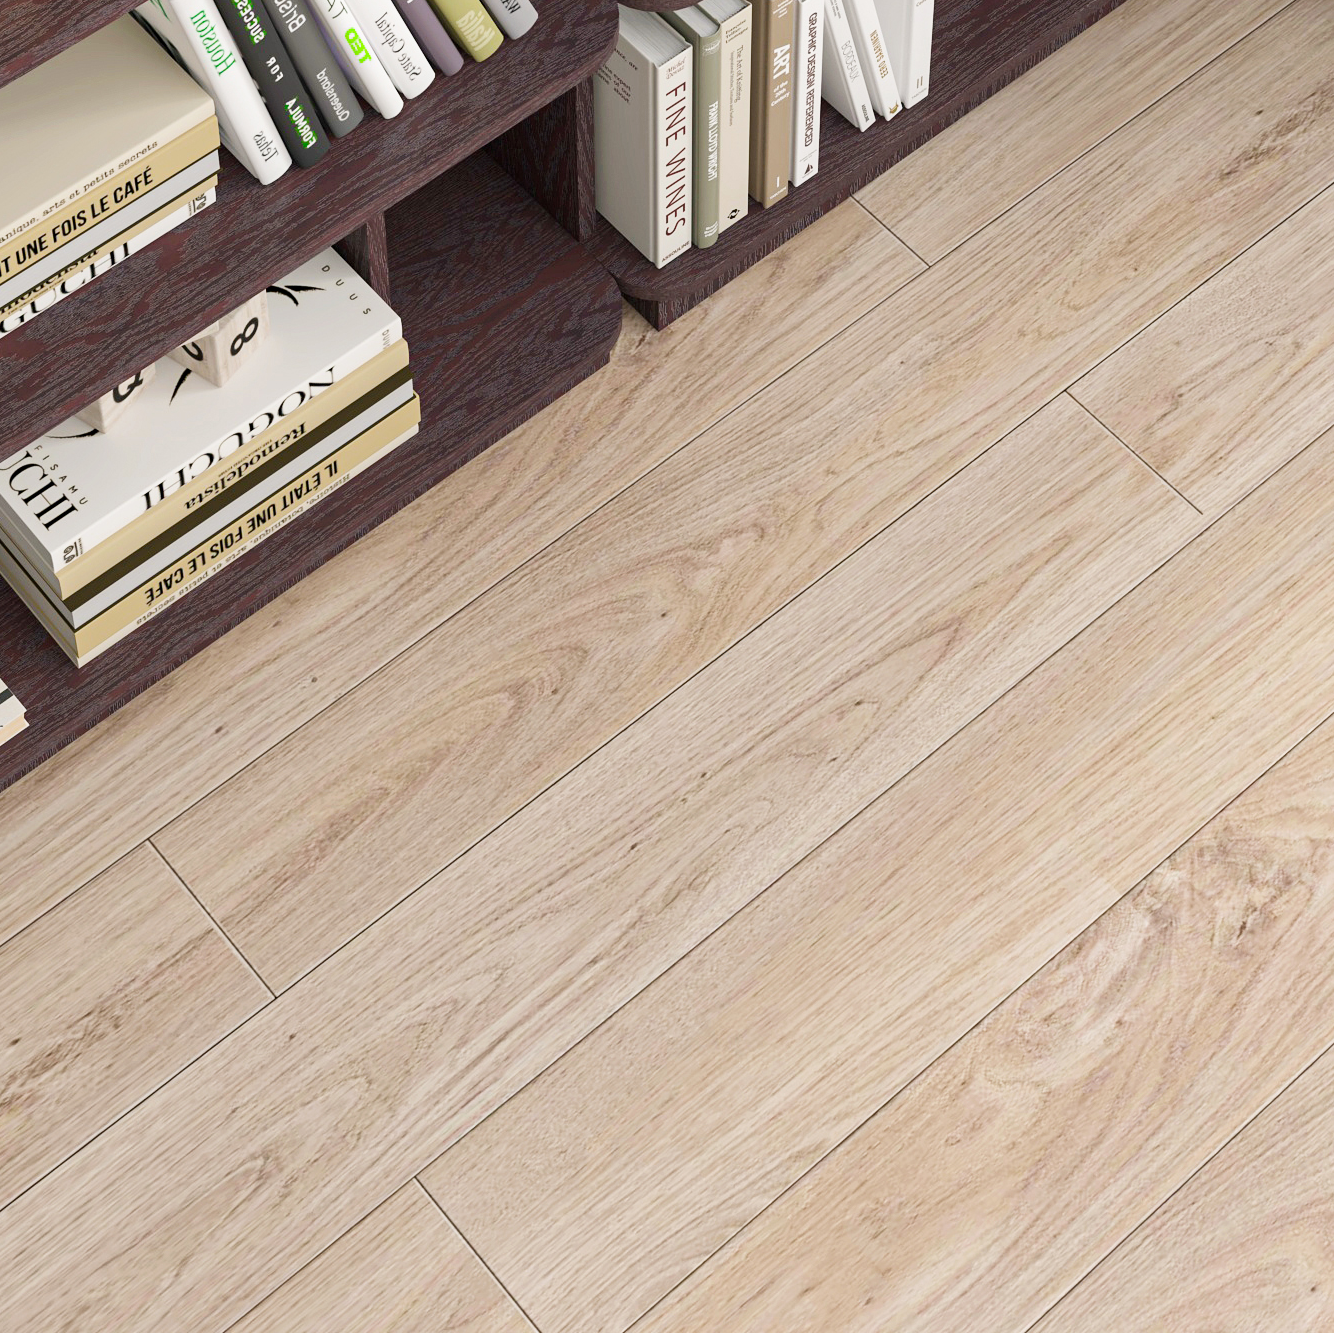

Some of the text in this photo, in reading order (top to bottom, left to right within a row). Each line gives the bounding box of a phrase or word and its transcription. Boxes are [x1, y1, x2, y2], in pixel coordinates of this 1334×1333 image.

[773, 44, 790, 79] ART
[42, 199, 66, 217] arts
[83, 168, 115, 193] petits
[117, 141, 158, 170] secrets
[666, 82, 686, 236] FINE WINES
[16, 234, 49, 265] UNE
[52, 210, 87, 243] FOIS
[90, 194, 110, 218] LE
[113, 165, 154, 205] CAFÉ
[141, 365, 336, 511] NOGUCHI
[183, 420, 307, 511] Remodelista
